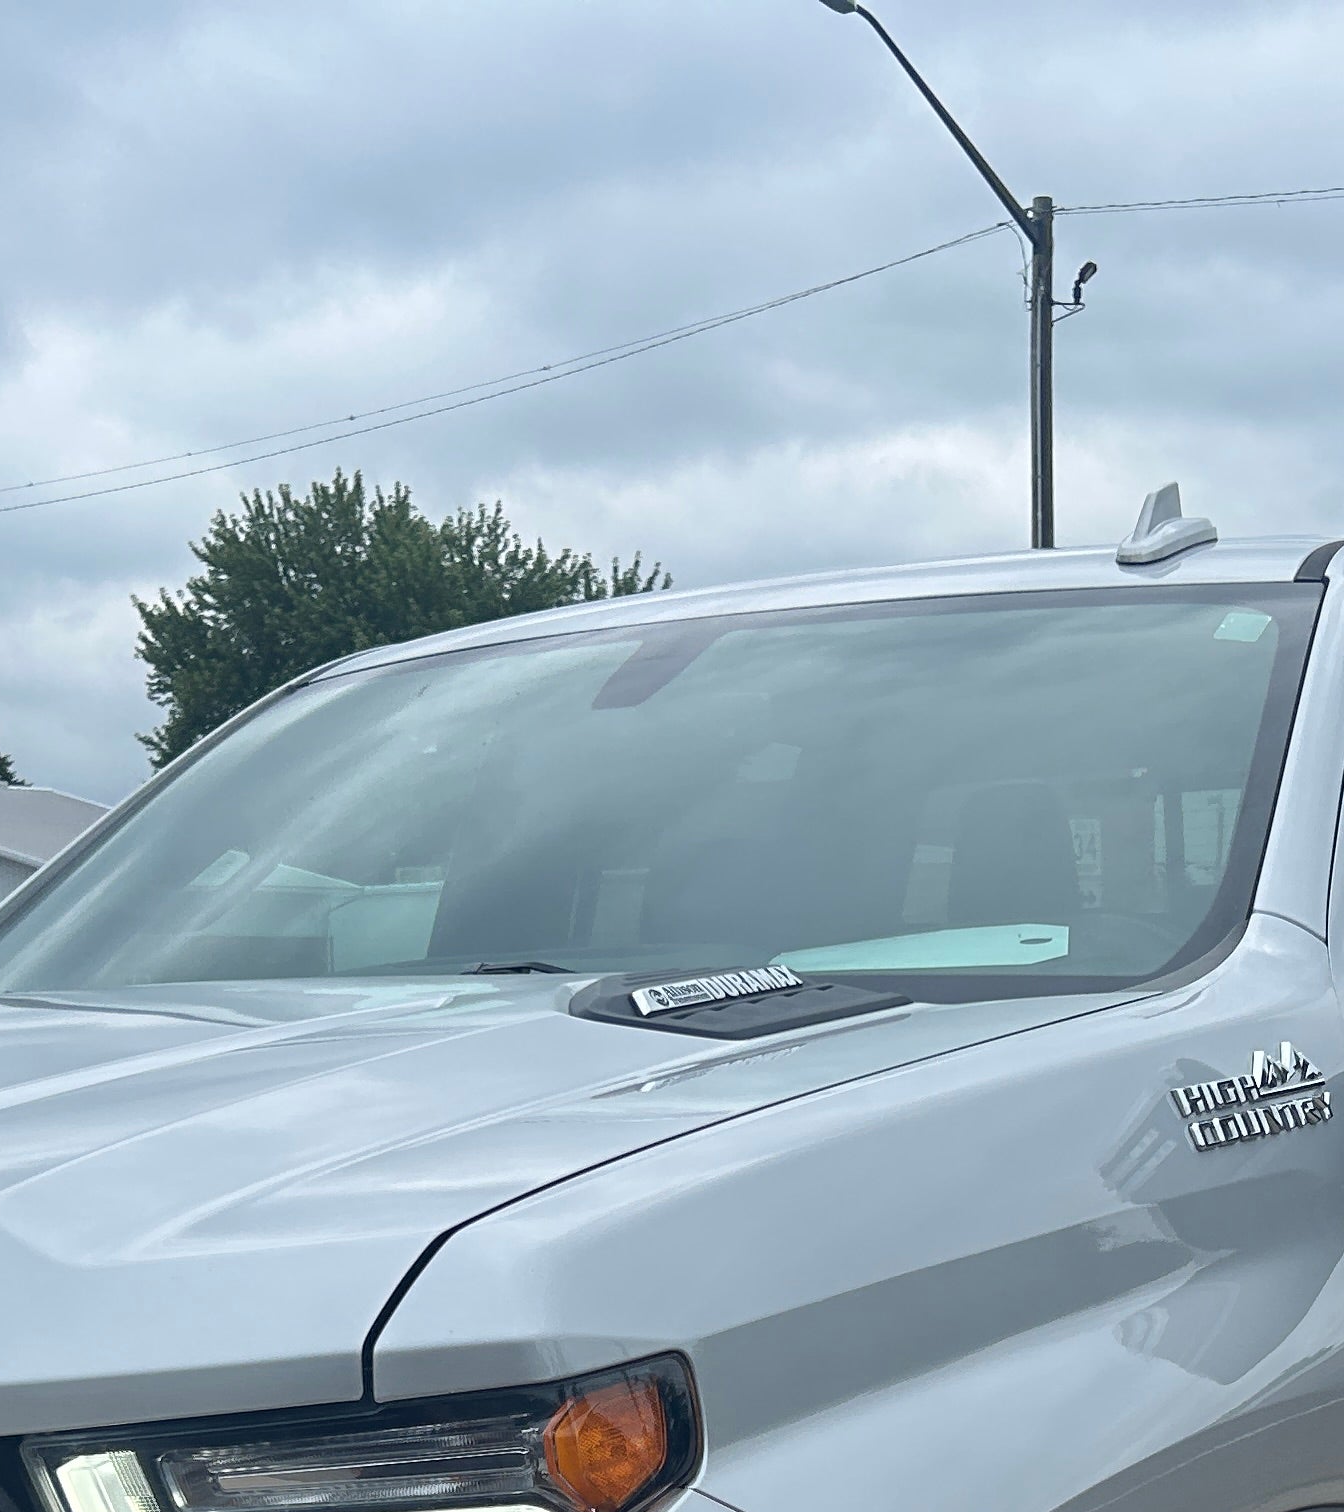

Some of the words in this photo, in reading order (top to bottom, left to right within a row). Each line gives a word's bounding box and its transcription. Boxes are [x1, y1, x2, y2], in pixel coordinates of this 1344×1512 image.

[697, 965, 803, 1000] DURAMAX
[1170, 1074, 1260, 1117] HIGH
[1188, 1092, 1334, 1151] COUNTRY
